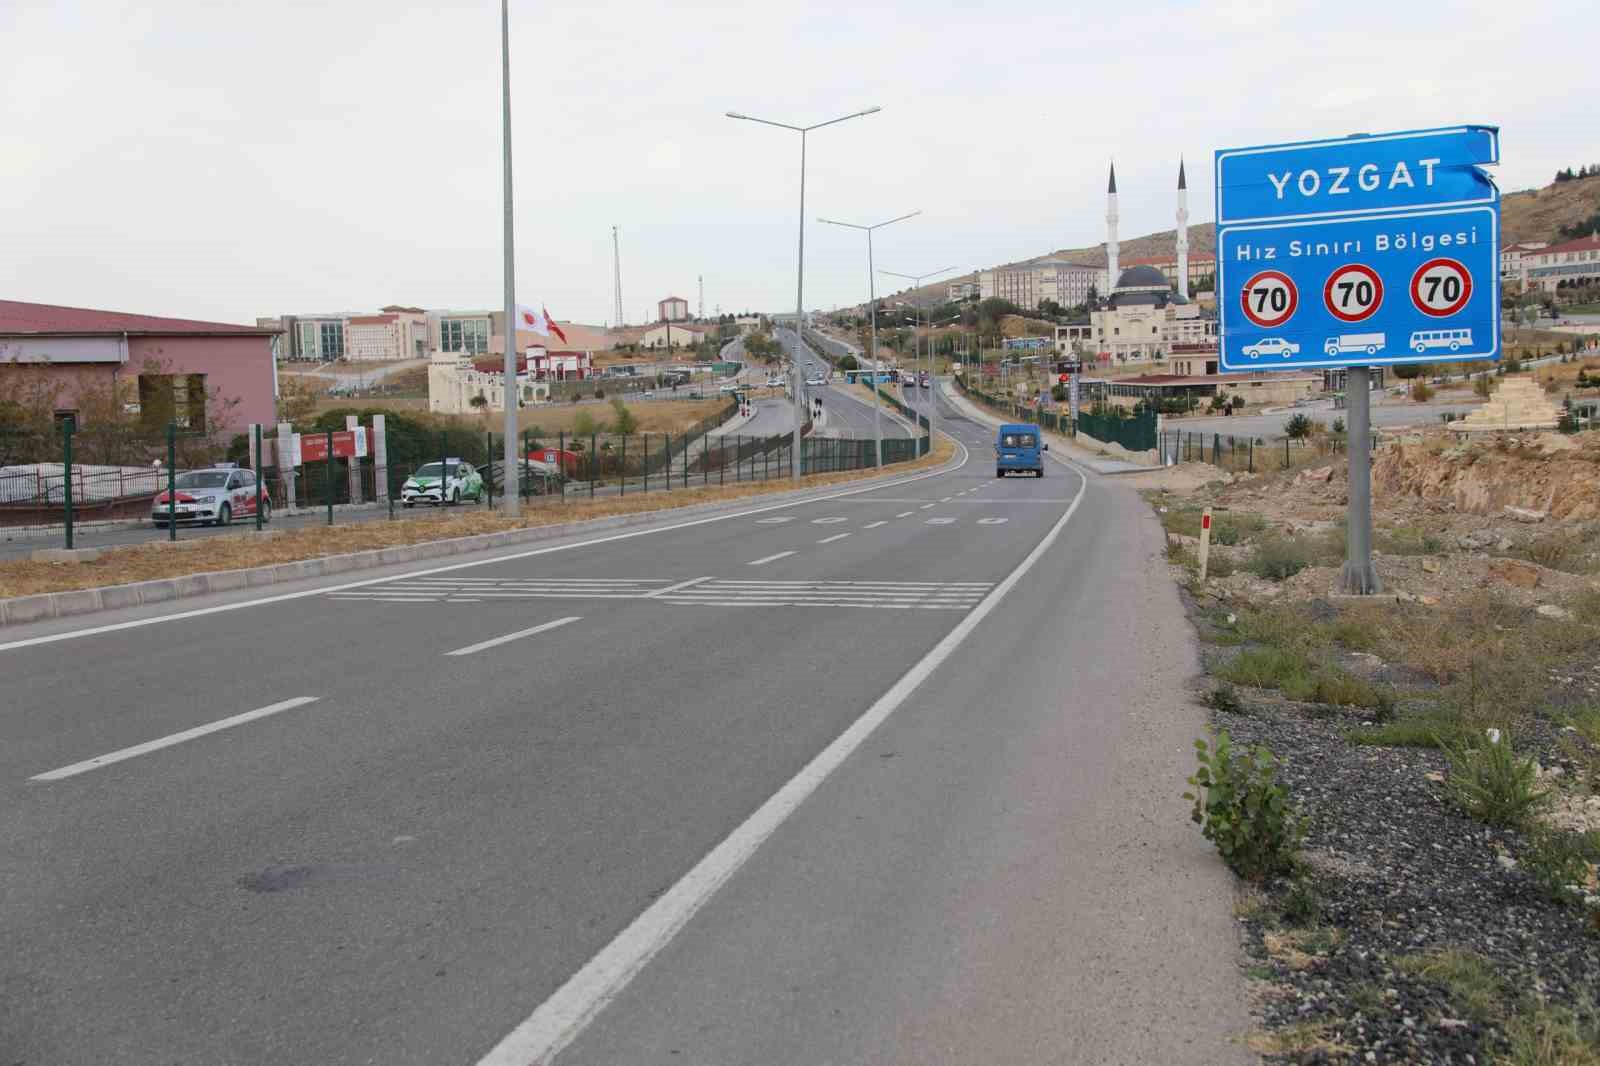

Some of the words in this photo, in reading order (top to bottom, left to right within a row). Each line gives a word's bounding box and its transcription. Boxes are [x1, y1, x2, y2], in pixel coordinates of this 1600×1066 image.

[1268, 158, 1441, 199] YOZGAT
[1236, 244, 1276, 261] Hız
[1289, 240, 1361, 257] Sınırı
[1375, 226, 1478, 252] Bölgesi
[1253, 287, 1287, 313] 70
[1338, 281, 1373, 307] 70
[1424, 275, 1461, 302] 70
